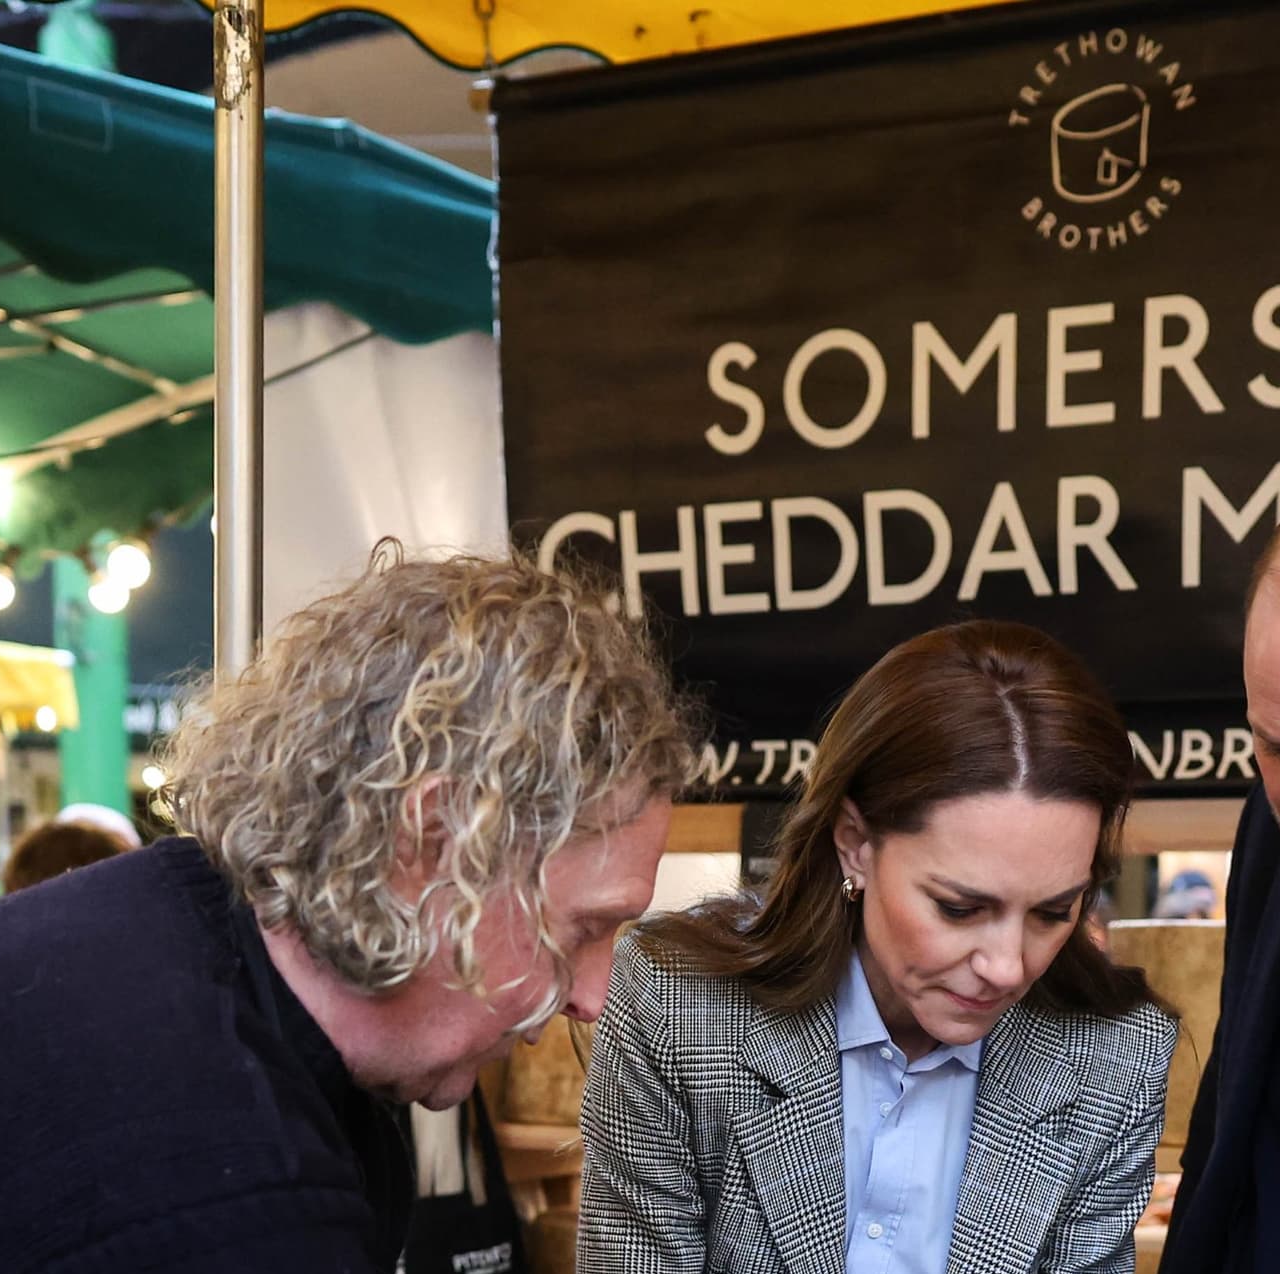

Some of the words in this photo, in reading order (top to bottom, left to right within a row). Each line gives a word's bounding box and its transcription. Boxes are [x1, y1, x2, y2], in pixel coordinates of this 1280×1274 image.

[1008, 28, 1197, 127] TRETHOWAN
[1021, 177, 1182, 252] BROTHERS
[536, 475, 1139, 619] CHEDDAR
